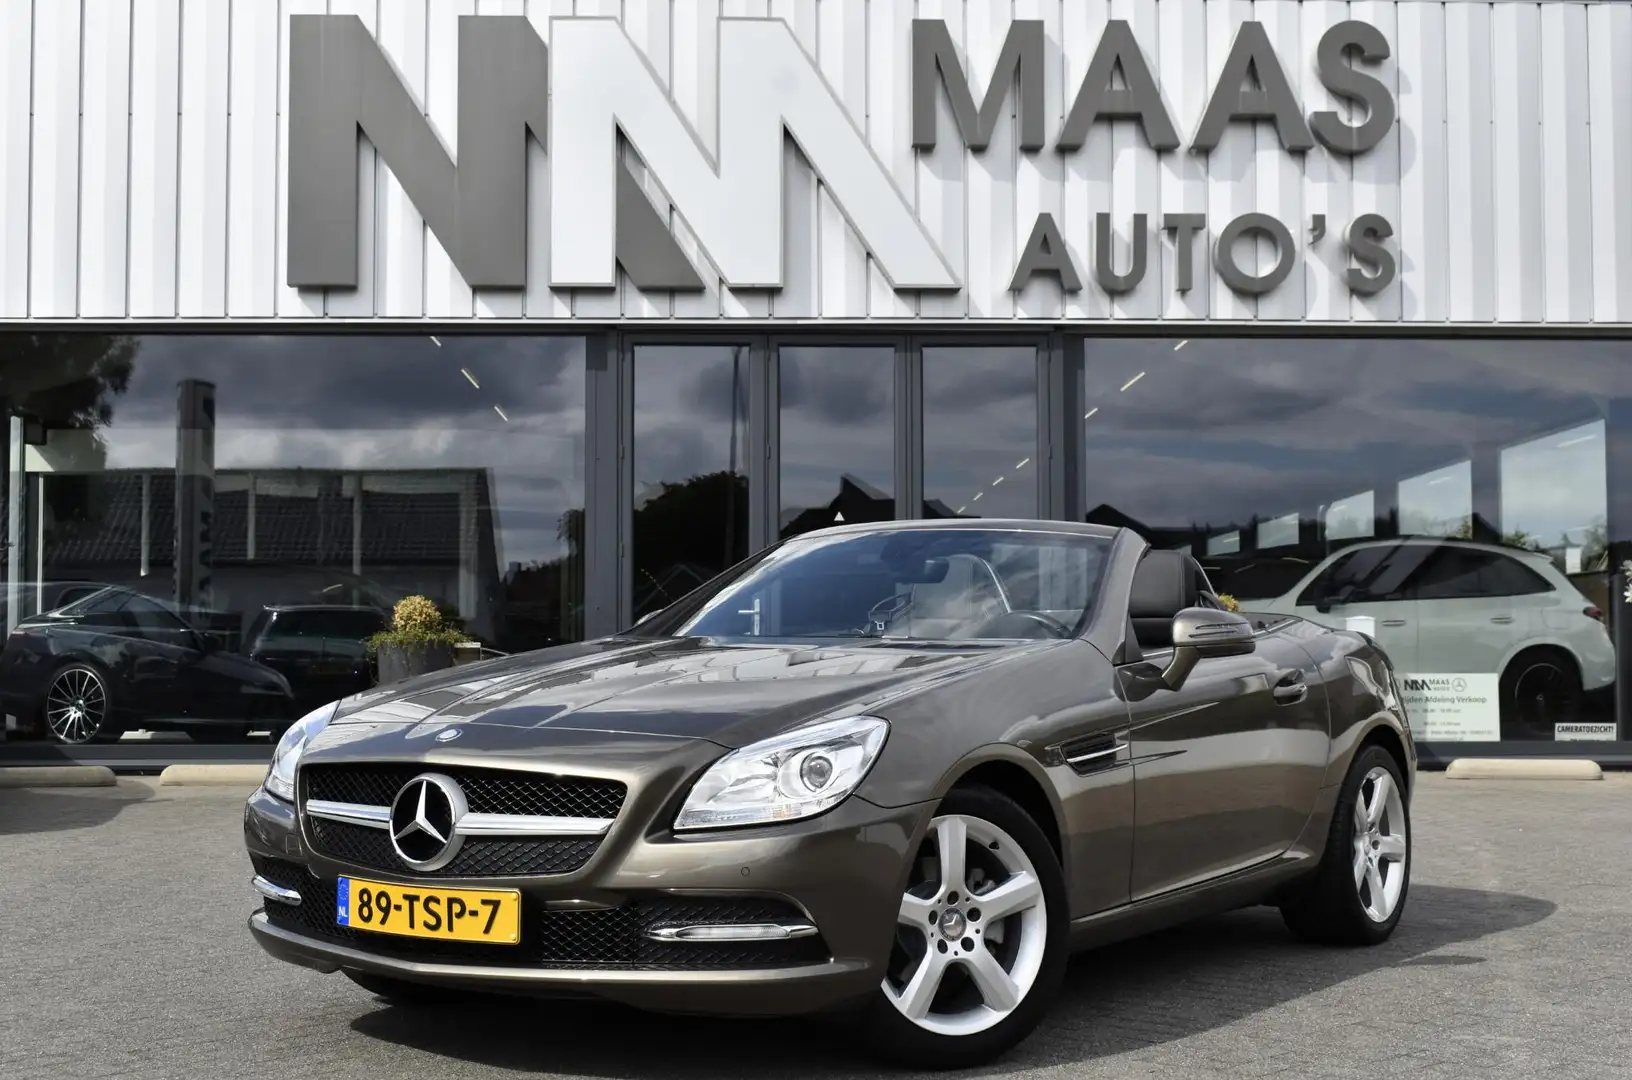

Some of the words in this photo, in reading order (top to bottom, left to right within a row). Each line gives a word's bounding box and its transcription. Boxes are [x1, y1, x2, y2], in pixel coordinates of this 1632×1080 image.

[912, 19, 1396, 154] MAAS
[1008, 212, 1397, 295] AUTO'S
[1456, 696, 1487, 704] Verkoop
[338, 905, 349, 918] NL
[358, 887, 501, 935] 89-TSP-7
